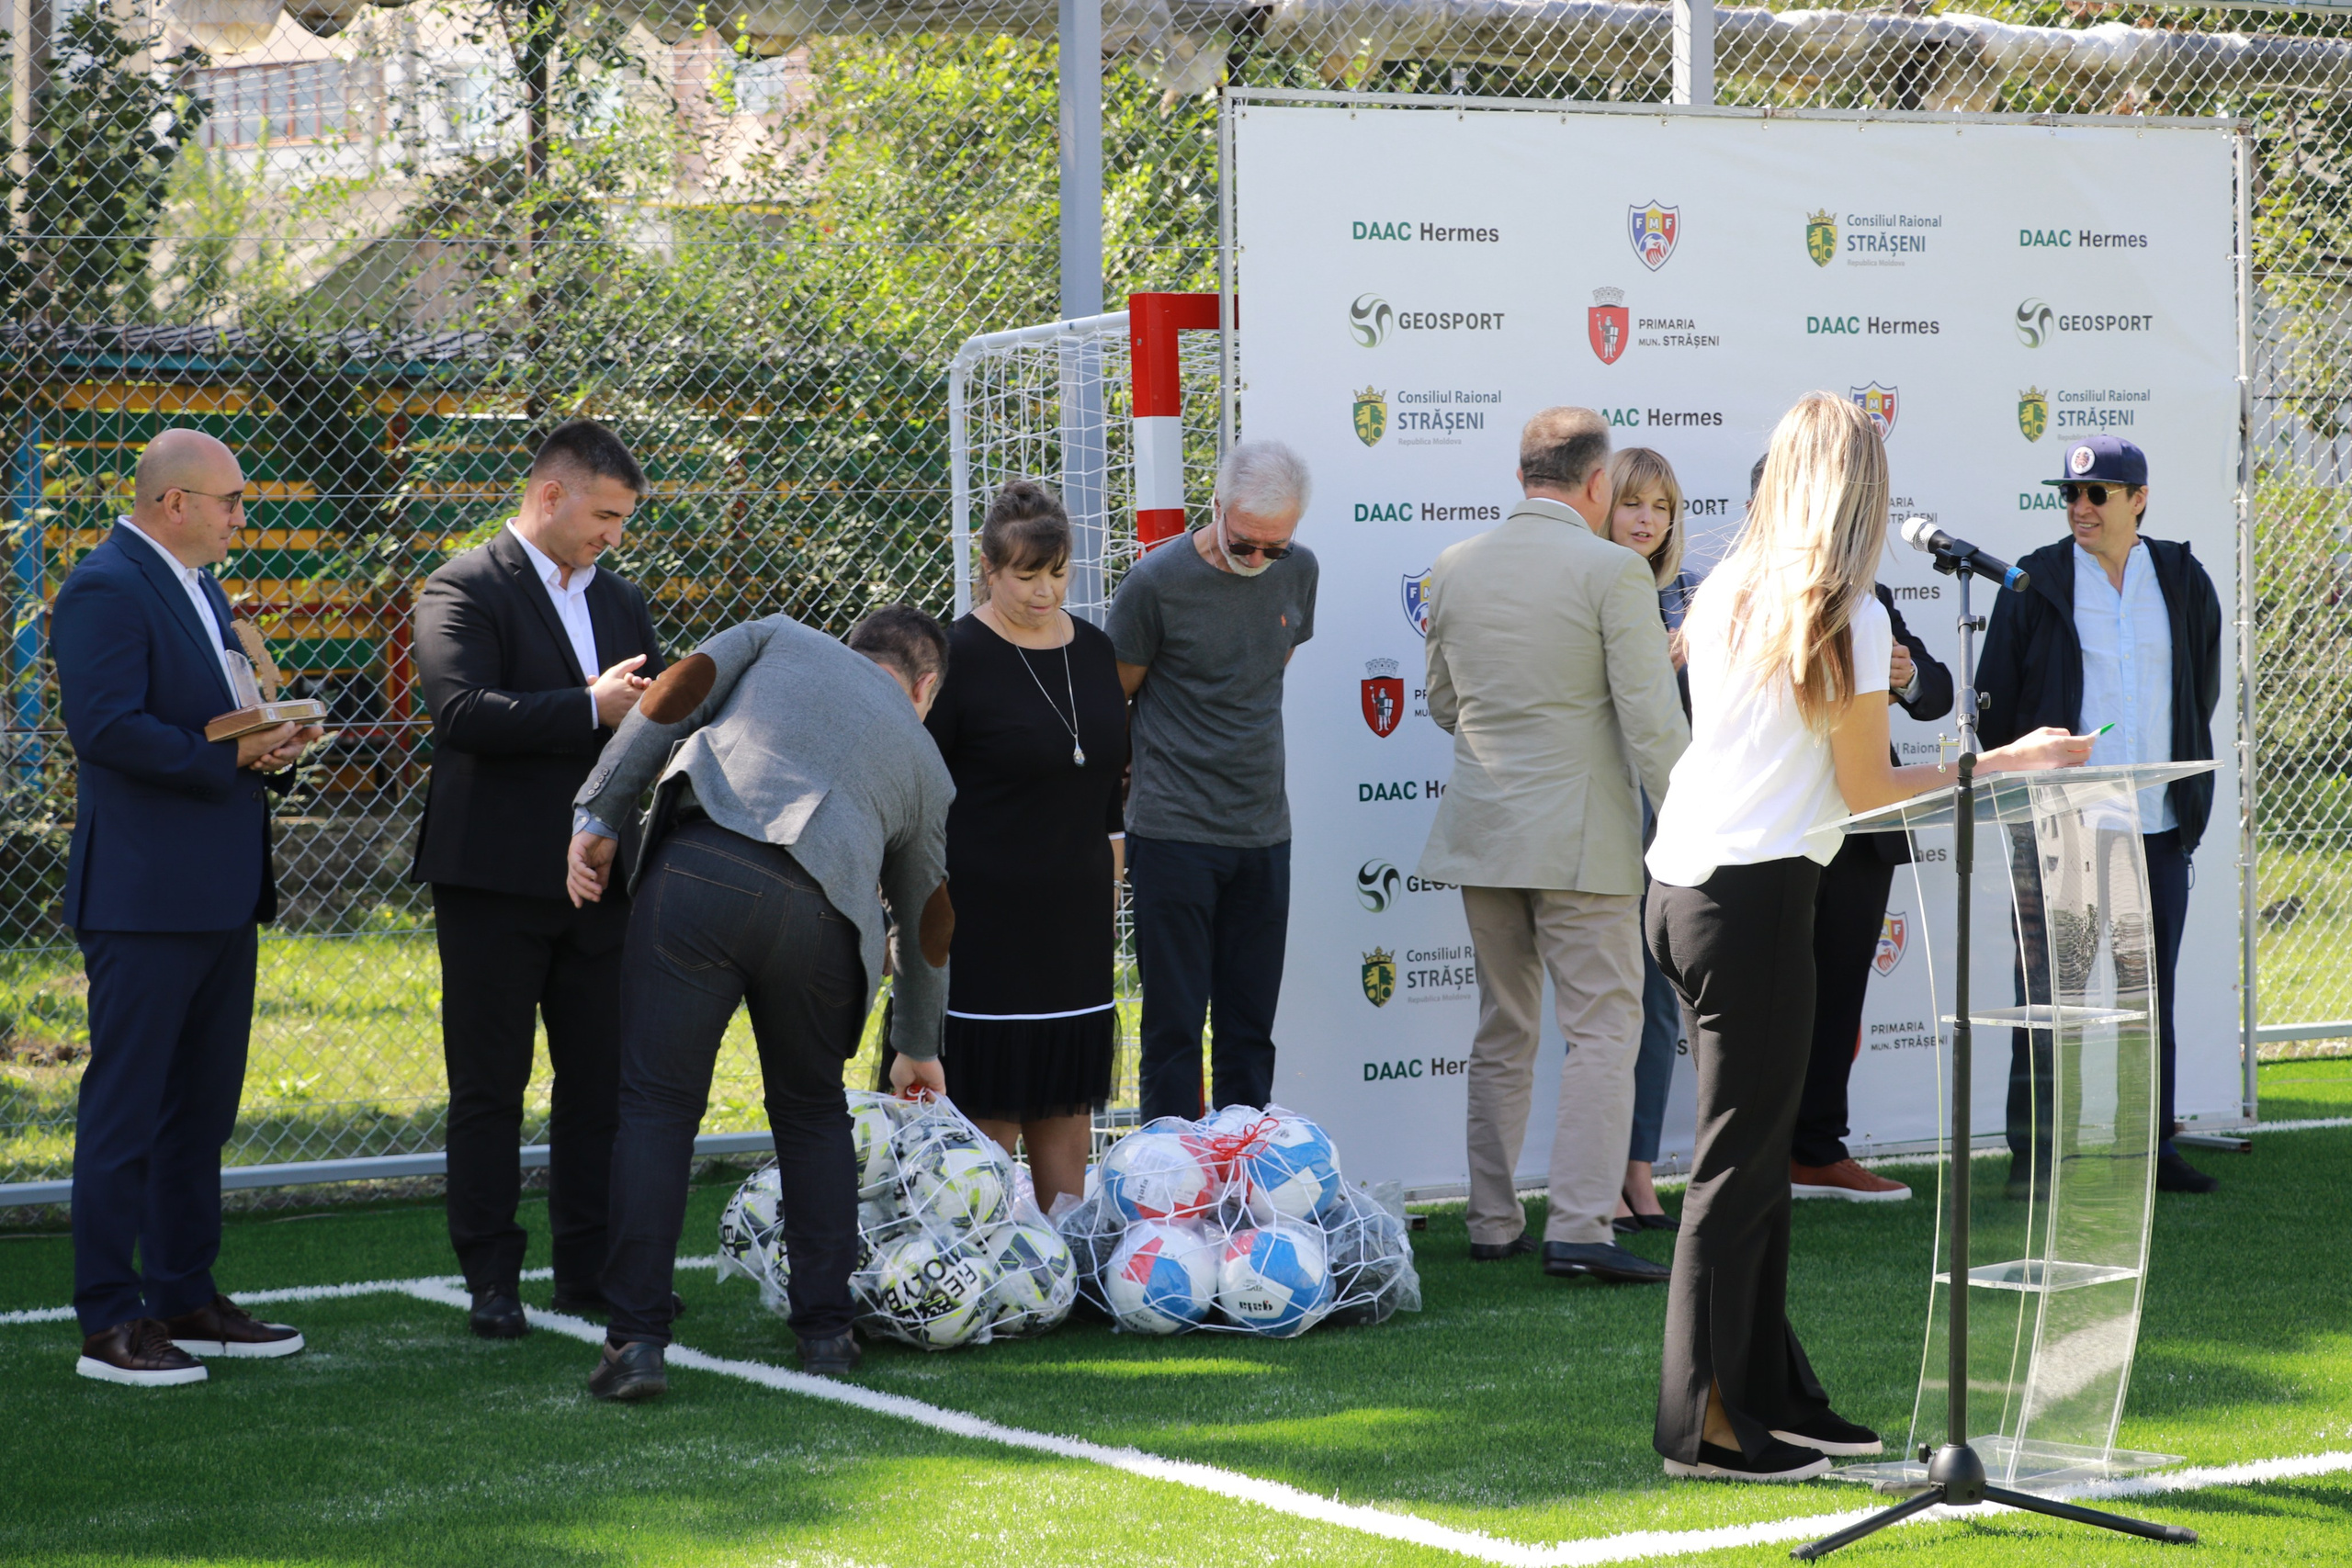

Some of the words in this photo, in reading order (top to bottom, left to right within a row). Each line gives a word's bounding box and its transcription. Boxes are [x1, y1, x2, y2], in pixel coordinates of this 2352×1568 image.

[1635, 217, 1674, 230] FMF
[1846, 213, 1896, 227] Consiliul
[1899, 214, 1942, 228] Raional
[1352, 220, 1412, 242] DAAC
[1419, 221, 1499, 243] Hermes
[2019, 229, 2072, 248] DAAC
[2078, 230, 2148, 248] Hermes
[1847, 231, 1926, 257] STRĂȘENI
[1846, 257, 1877, 268] Republica
[1878, 258, 1905, 267] Moldova
[1398, 311, 1505, 331] GEOSPORT
[1638, 318, 1696, 330] PRIMARIA
[1806, 315, 1860, 335] DAAC
[1867, 316, 1939, 335] Hermes
[2058, 314, 2154, 332] GEOSPORT
[1638, 338, 1661, 346] MUN.
[1662, 333, 1720, 349] STRĂȘENI
[1397, 389, 1452, 404] Consiliul
[1454, 389, 1502, 404] Raional
[2057, 389, 2106, 403] Consiliul
[2108, 389, 2151, 402] Raional
[1397, 408, 1484, 435] STRĂȘENI
[1601, 408, 1640, 427] AAC
[1647, 408, 1723, 427] Hermes
[2057, 406, 2134, 432] STRĂȘENI
[1397, 437, 1431, 449] Republica
[1433, 436, 1462, 446] Moldova
[1354, 502, 1413, 523] DAAC
[1421, 502, 1500, 522] Hermes
[1683, 499, 1728, 515] PORT
[1894, 586, 1940, 600] rmes
[1903, 742, 1940, 754] Raiona
[1358, 780, 1418, 803] DAAC
[1406, 945, 1461, 963] Consiliul
[1407, 964, 1475, 991] STRĂȘE
[1408, 995, 1441, 1005] Republica
[1871, 1021, 1925, 1035] PRIMARIA
[1363, 1058, 1423, 1082] DAAC
[1430, 1056, 1468, 1077] Her
